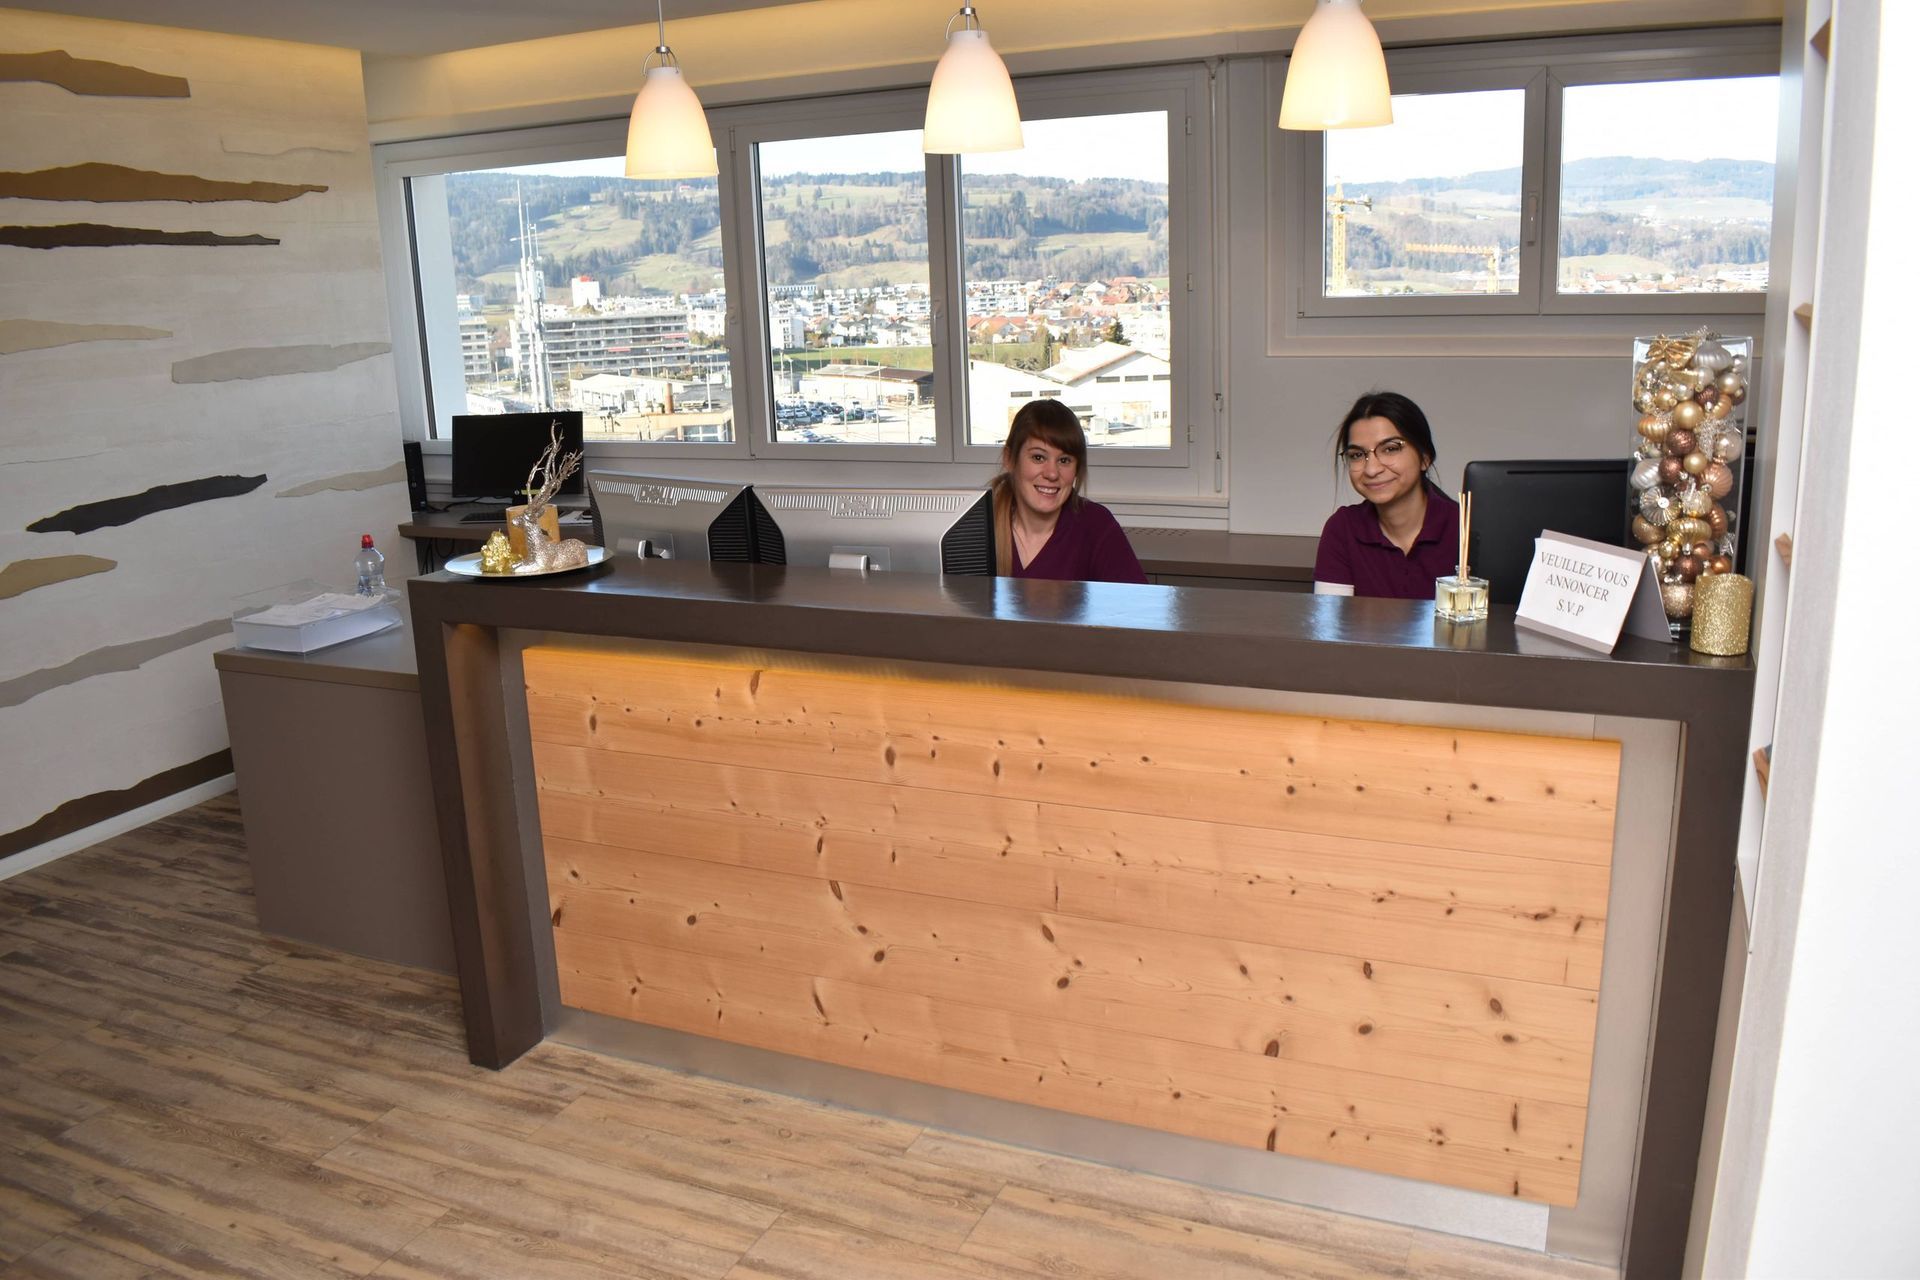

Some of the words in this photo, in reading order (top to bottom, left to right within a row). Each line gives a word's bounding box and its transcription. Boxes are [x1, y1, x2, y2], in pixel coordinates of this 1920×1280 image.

[1541, 551, 1595, 580] VEUILLEZ
[1597, 567, 1630, 588] VOUS
[1545, 573, 1610, 602] ANNONCER
